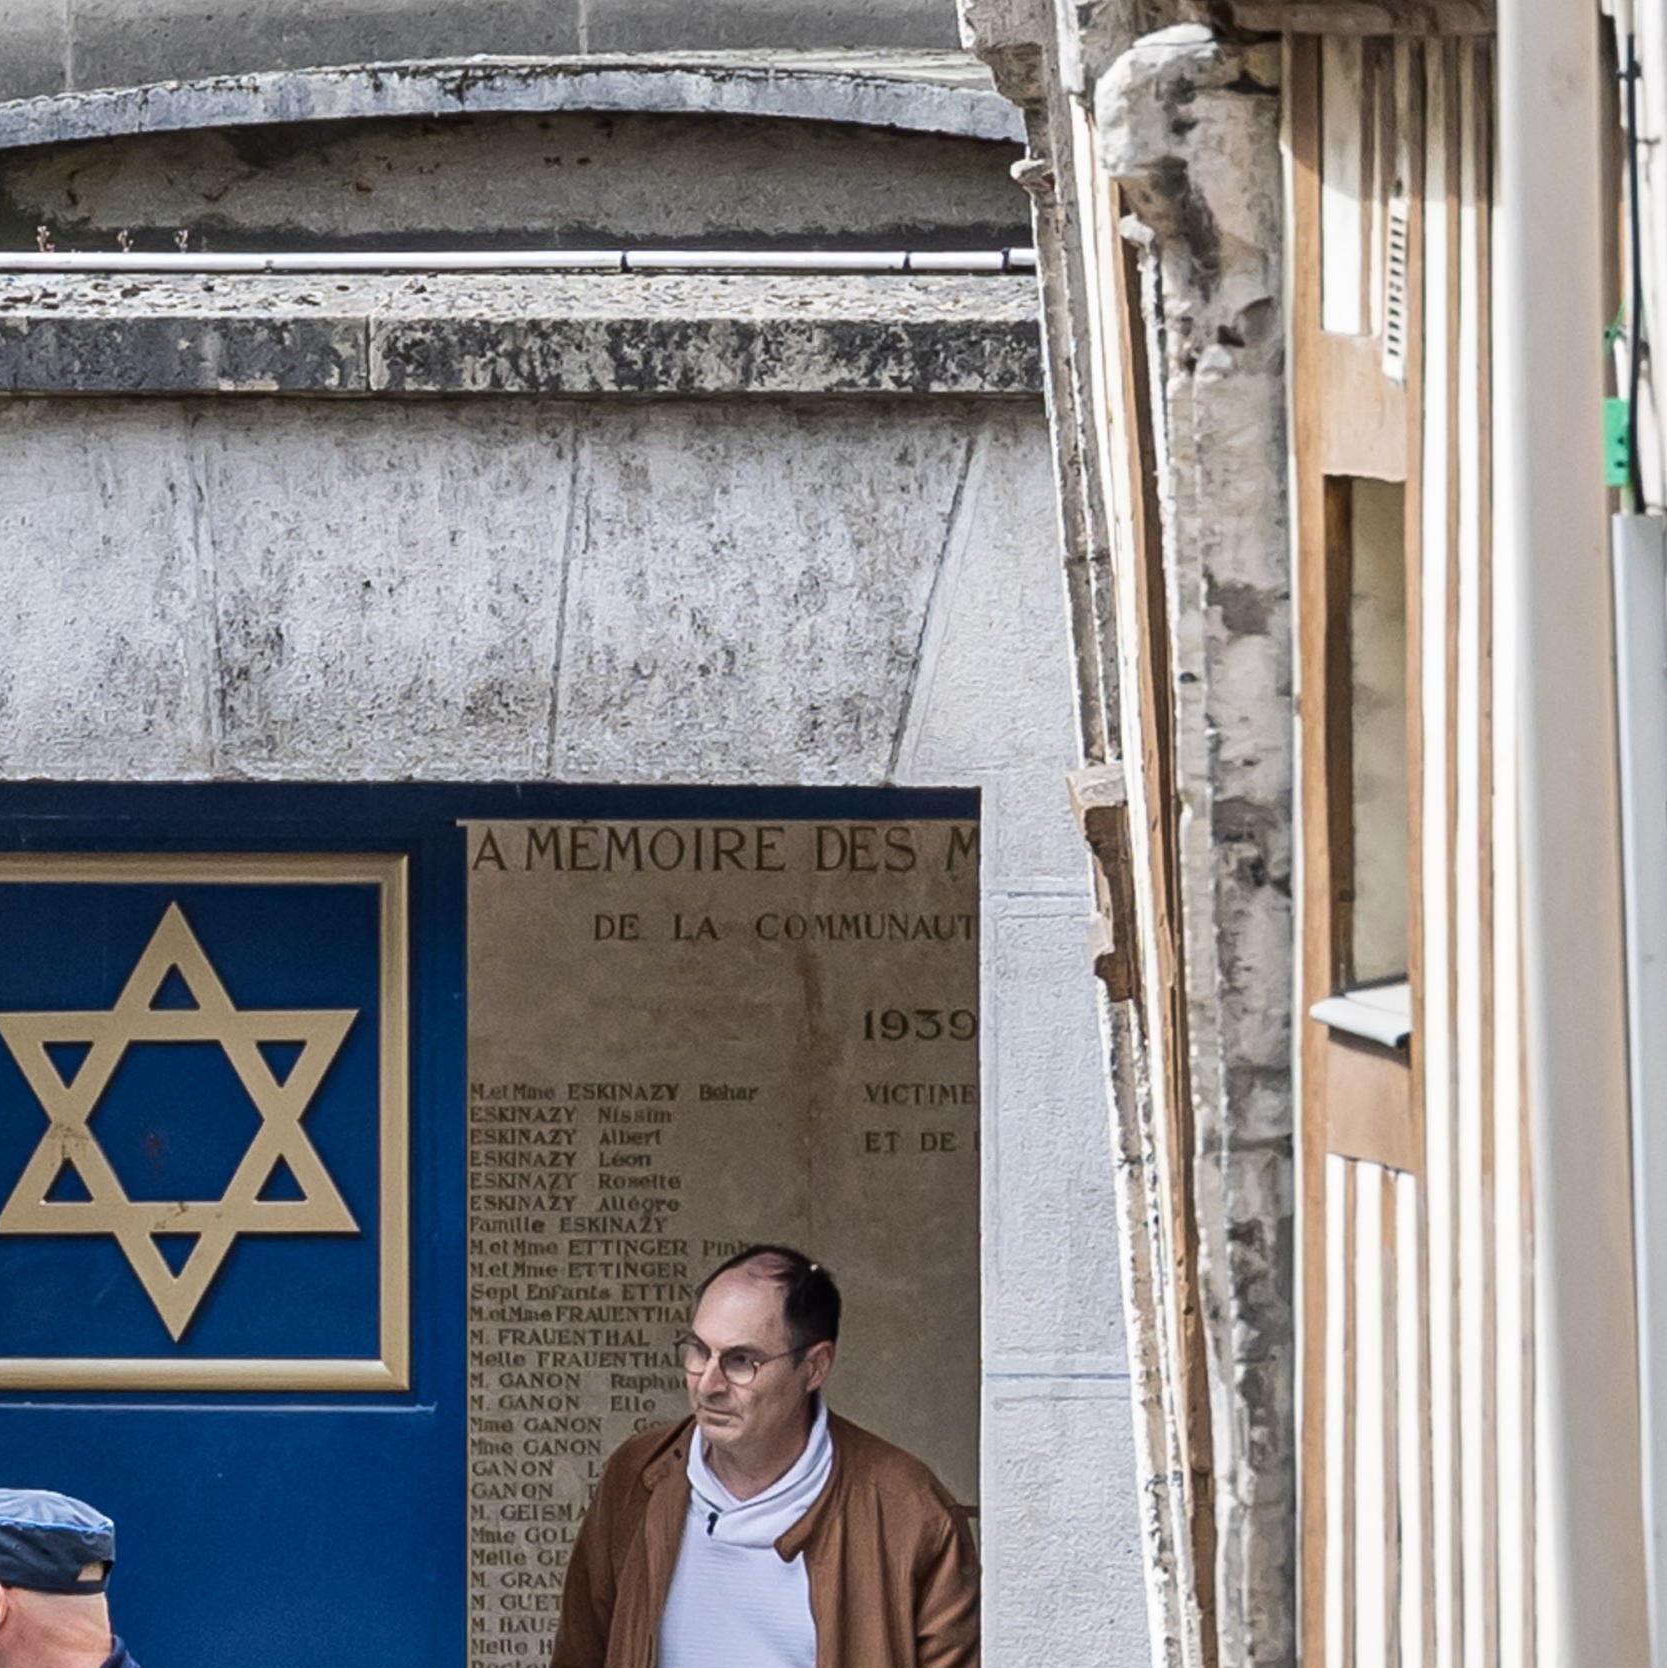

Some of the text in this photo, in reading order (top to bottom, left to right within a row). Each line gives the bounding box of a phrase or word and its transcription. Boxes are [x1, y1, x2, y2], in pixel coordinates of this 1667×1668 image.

[814, 826, 916, 872] DES
[593, 913, 640, 942] DE
[673, 913, 721, 942] LA
[863, 1009, 979, 1042] 1939
[567, 1083, 680, 1102] ESKINAZY
[470, 1106, 576, 1123] ESKINAZY
[470, 1129, 576, 1145] ESKINAZY
[864, 1132, 957, 1154] ET DE
[470, 1151, 576, 1167] ESKINAZY
[470, 1173, 576, 1190] ESKINAZY
[470, 1195, 576, 1212] ESKINAZY
[470, 1216, 666, 1233] Famille ESKINAZY
[568, 1239, 688, 1256] ETTINGER
[568, 1262, 687, 1279] ETTINGER
[525, 1284, 611, 1301] Enfants
[498, 1329, 651, 1346] FRAUENTHAL
[498, 1372, 581, 1389] GANON
[498, 1395, 581, 1411] GANON
[523, 1416, 603, 1433] GANON
[523, 1438, 603, 1456] GANON
[471, 1460, 554, 1477] GANON
[471, 1482, 554, 1500] GANON
[471, 1549, 527, 1566] Melle
